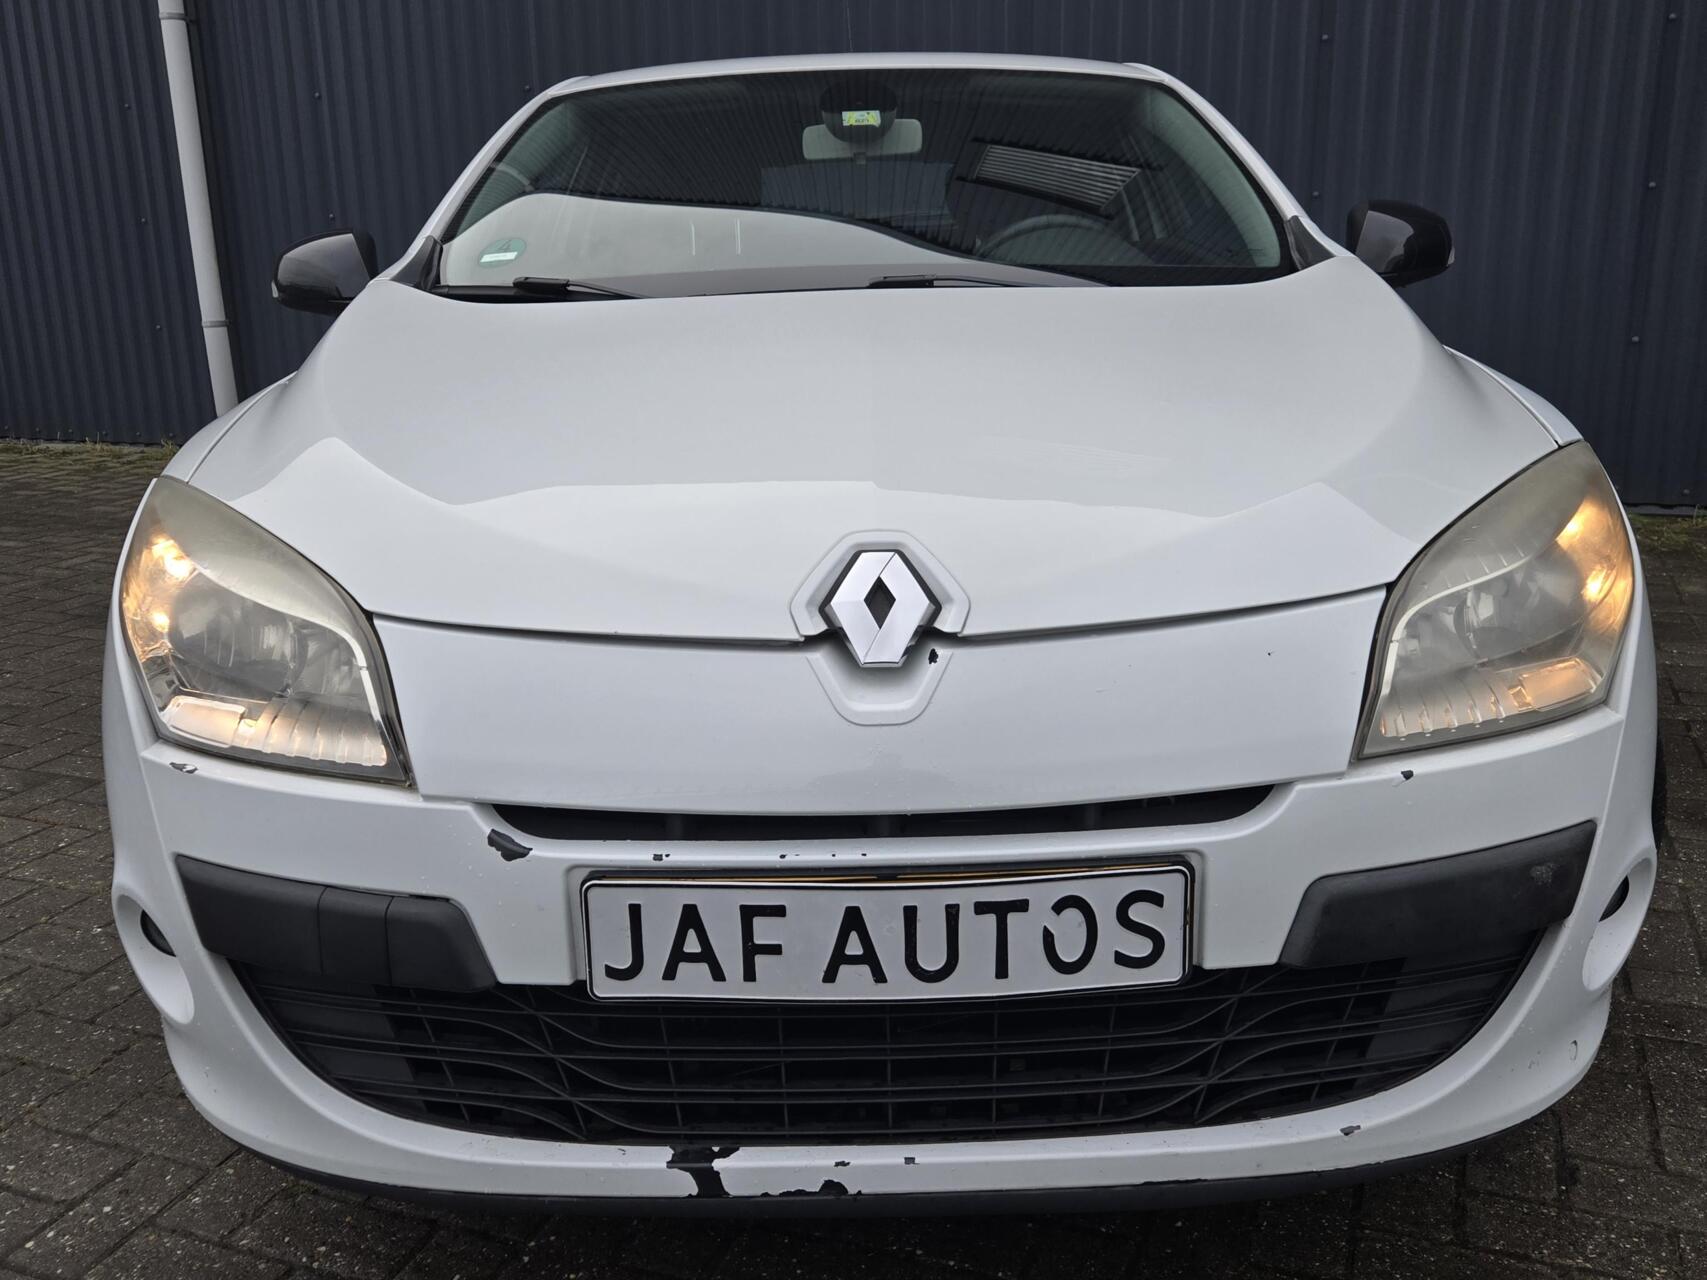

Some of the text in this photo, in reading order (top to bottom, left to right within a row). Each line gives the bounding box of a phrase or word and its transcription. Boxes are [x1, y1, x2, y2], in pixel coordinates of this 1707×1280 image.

[497, 239, 512, 252] 4
[604, 889, 1166, 984] JAF AUTOS
